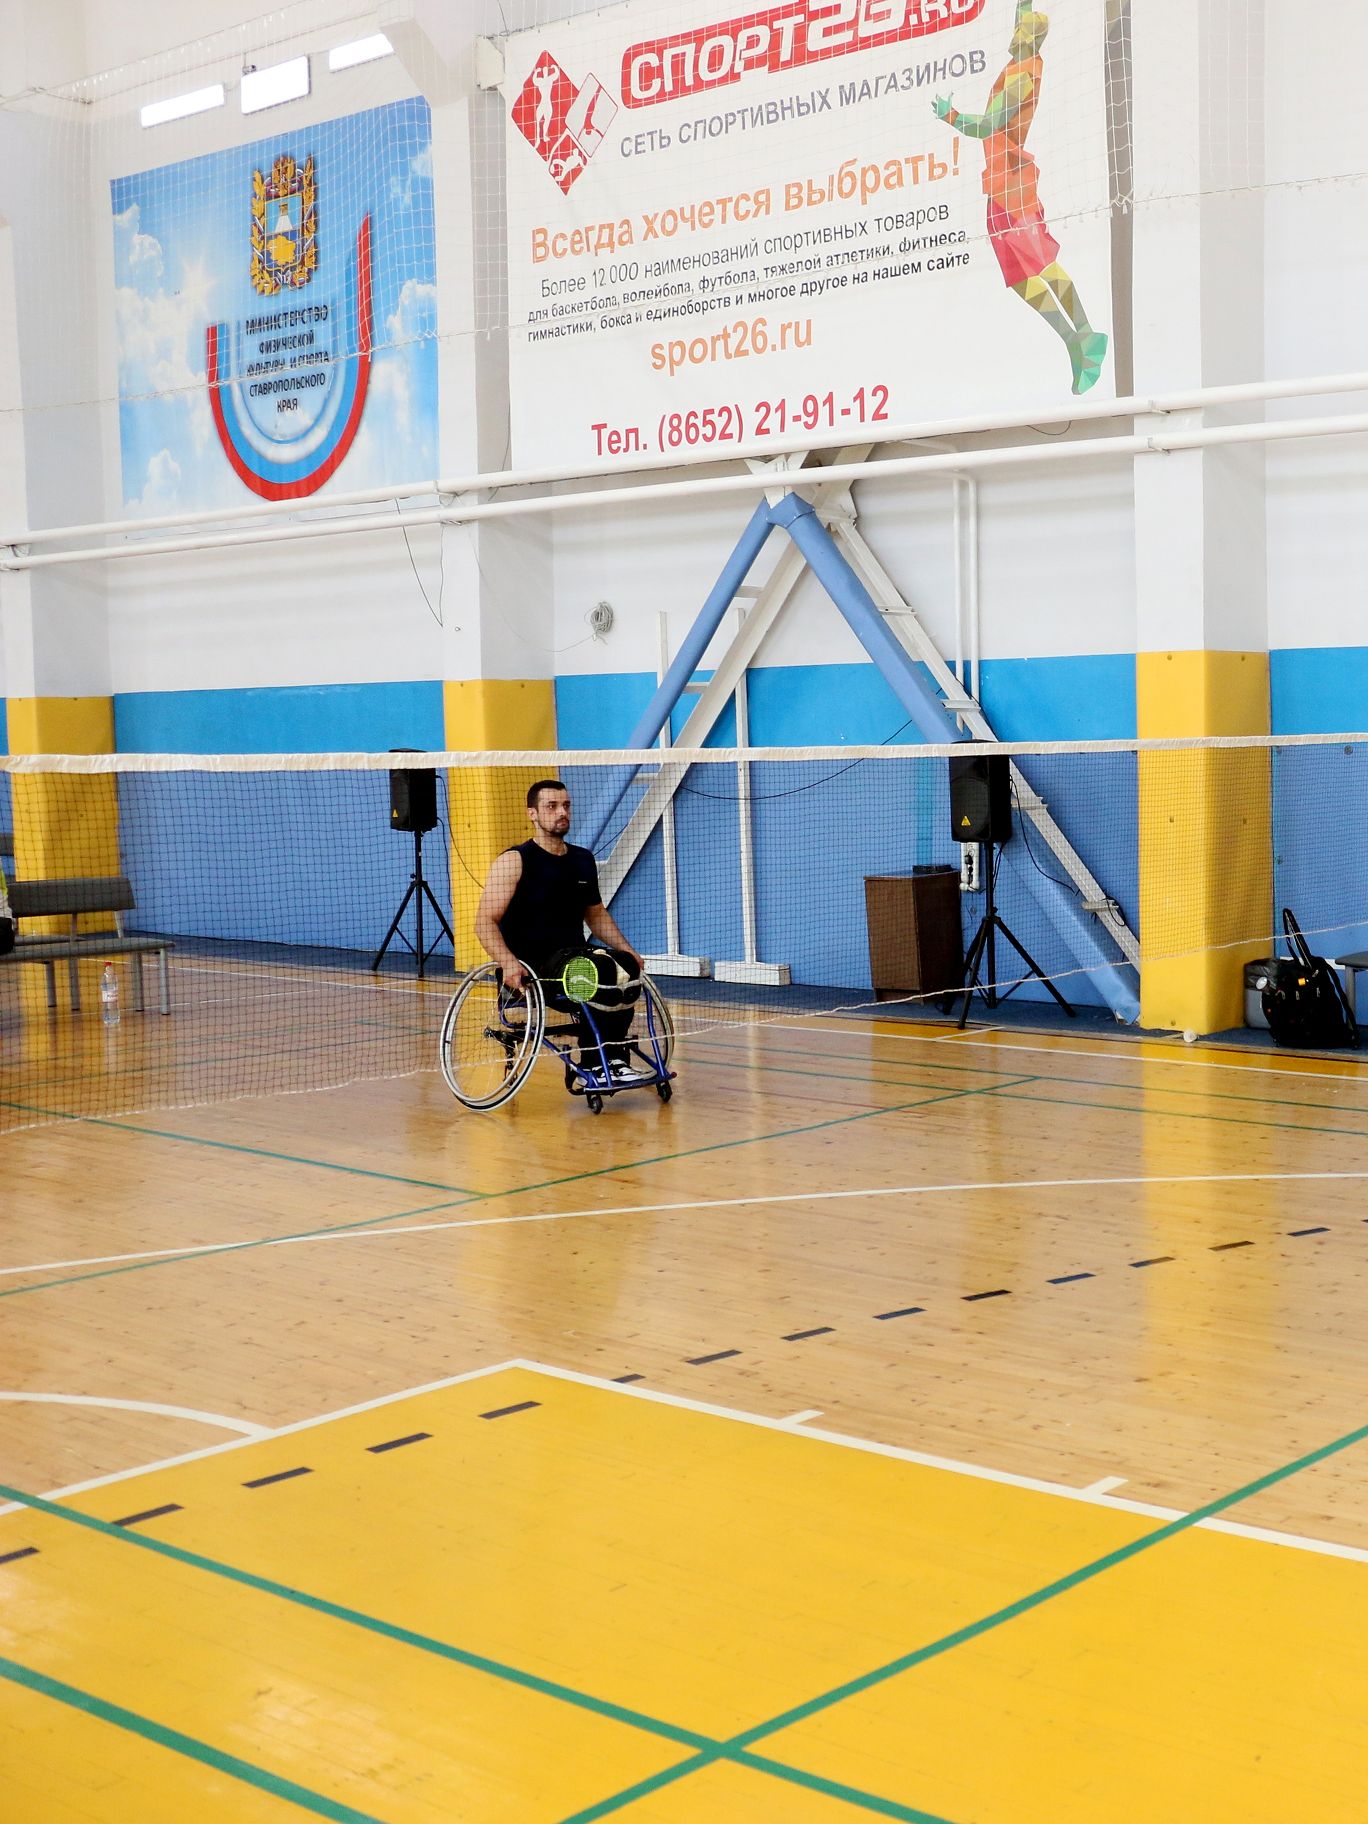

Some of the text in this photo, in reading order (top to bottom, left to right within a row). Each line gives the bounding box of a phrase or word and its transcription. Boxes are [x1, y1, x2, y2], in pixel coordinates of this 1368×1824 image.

[621, 49, 987, 158] СЕТЬ СПОРТИВНЫХ МАГАЗИНОВ
[531, 136, 960, 264] Всегда хочется выбрать!
[528, 308, 549, 323] для
[551, 295, 620, 317] баскетбола,
[623, 281, 694, 304] волейбола,
[699, 269, 760, 293] футбола,
[763, 253, 822, 278] тяжелой
[826, 244, 894, 267] атлетики,
[541, 277, 586, 298] Более
[644, 237, 760, 279] наименований
[764, 220, 869, 255] спортивных
[874, 204, 950, 233] товаров
[246, 304, 328, 335] МИНИСТЕРСТВО
[528, 252, 970, 342] гимнастики, бокса и единоборств и многое другое на нашем сайте
[259, 330, 315, 355] ФИЗИЧЕСКОЙ
[651, 317, 813, 376] sport26.ru
[249, 372, 326, 397] СТАВРОПОЛЬСКОГО
[277, 398, 298, 413] КРАЯ
[592, 384, 889, 456] Тел. (8652) 21-91-12
